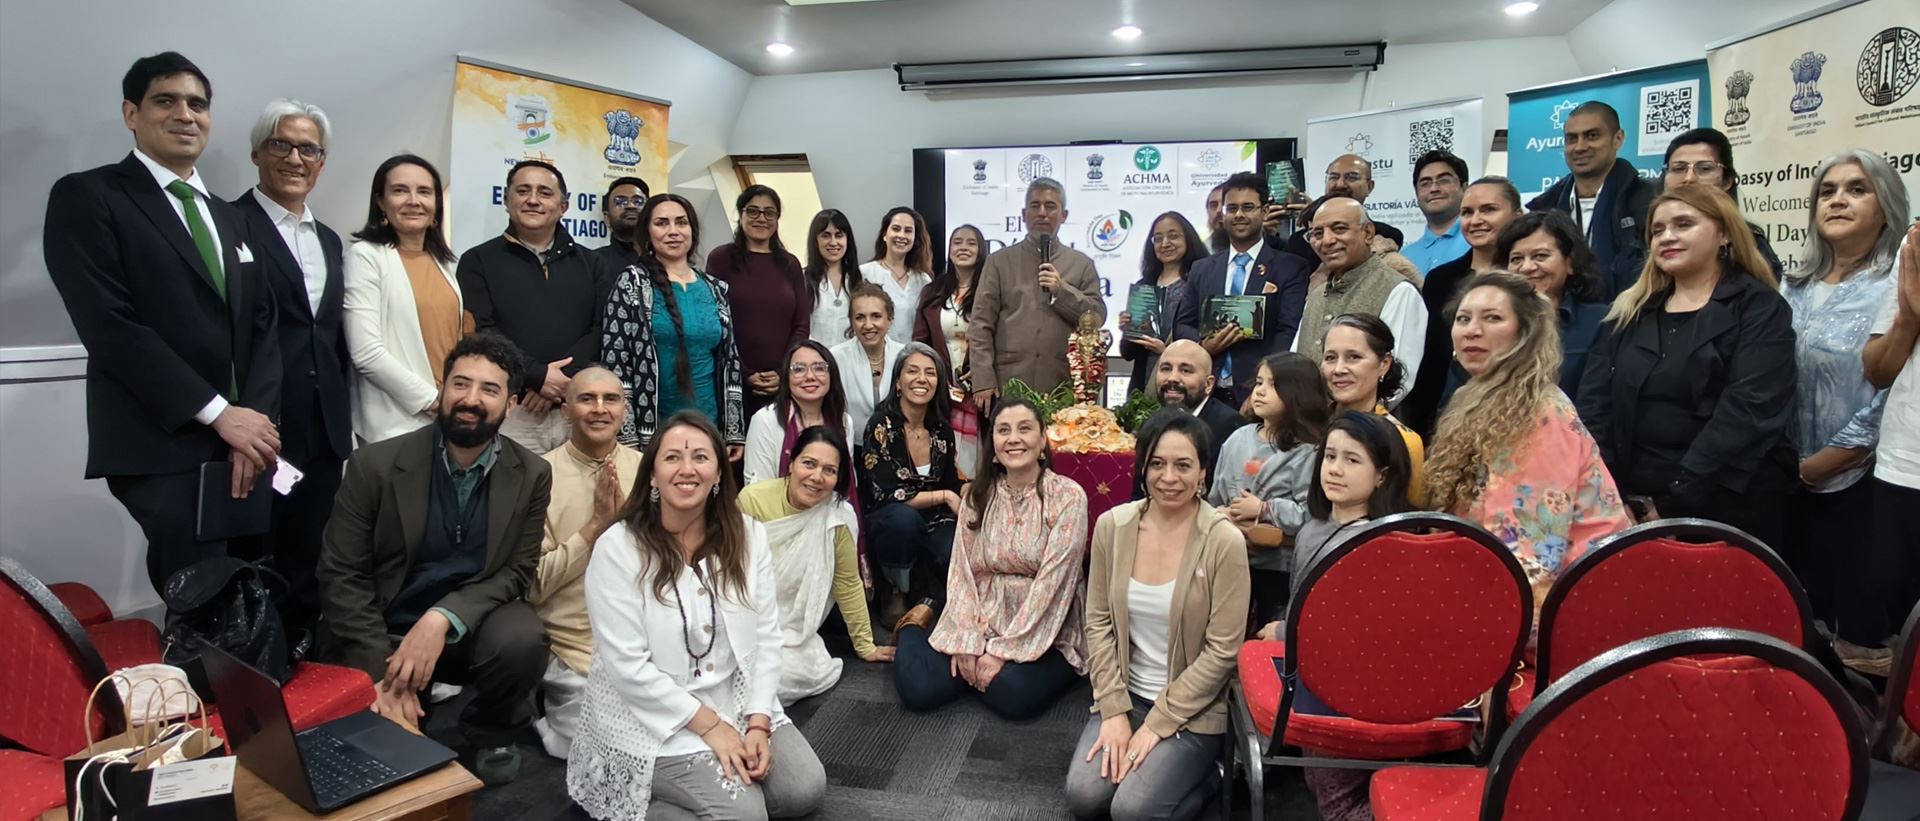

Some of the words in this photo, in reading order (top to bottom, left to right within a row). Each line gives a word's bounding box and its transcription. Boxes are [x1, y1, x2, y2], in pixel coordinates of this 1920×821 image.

[1526, 137, 1565, 152] Ayur
[1371, 159, 1393, 169] stu
[1123, 174, 1171, 184] ACHMA
[1777, 164, 1793, 182] of
[577, 193, 597, 211] OF
[1364, 199, 1403, 210] SULTORÍA
[1743, 195, 1810, 213] Welcome
[562, 218, 608, 238] TIAGO
[1005, 216, 1022, 232] El
[1777, 224, 1808, 247] Day
